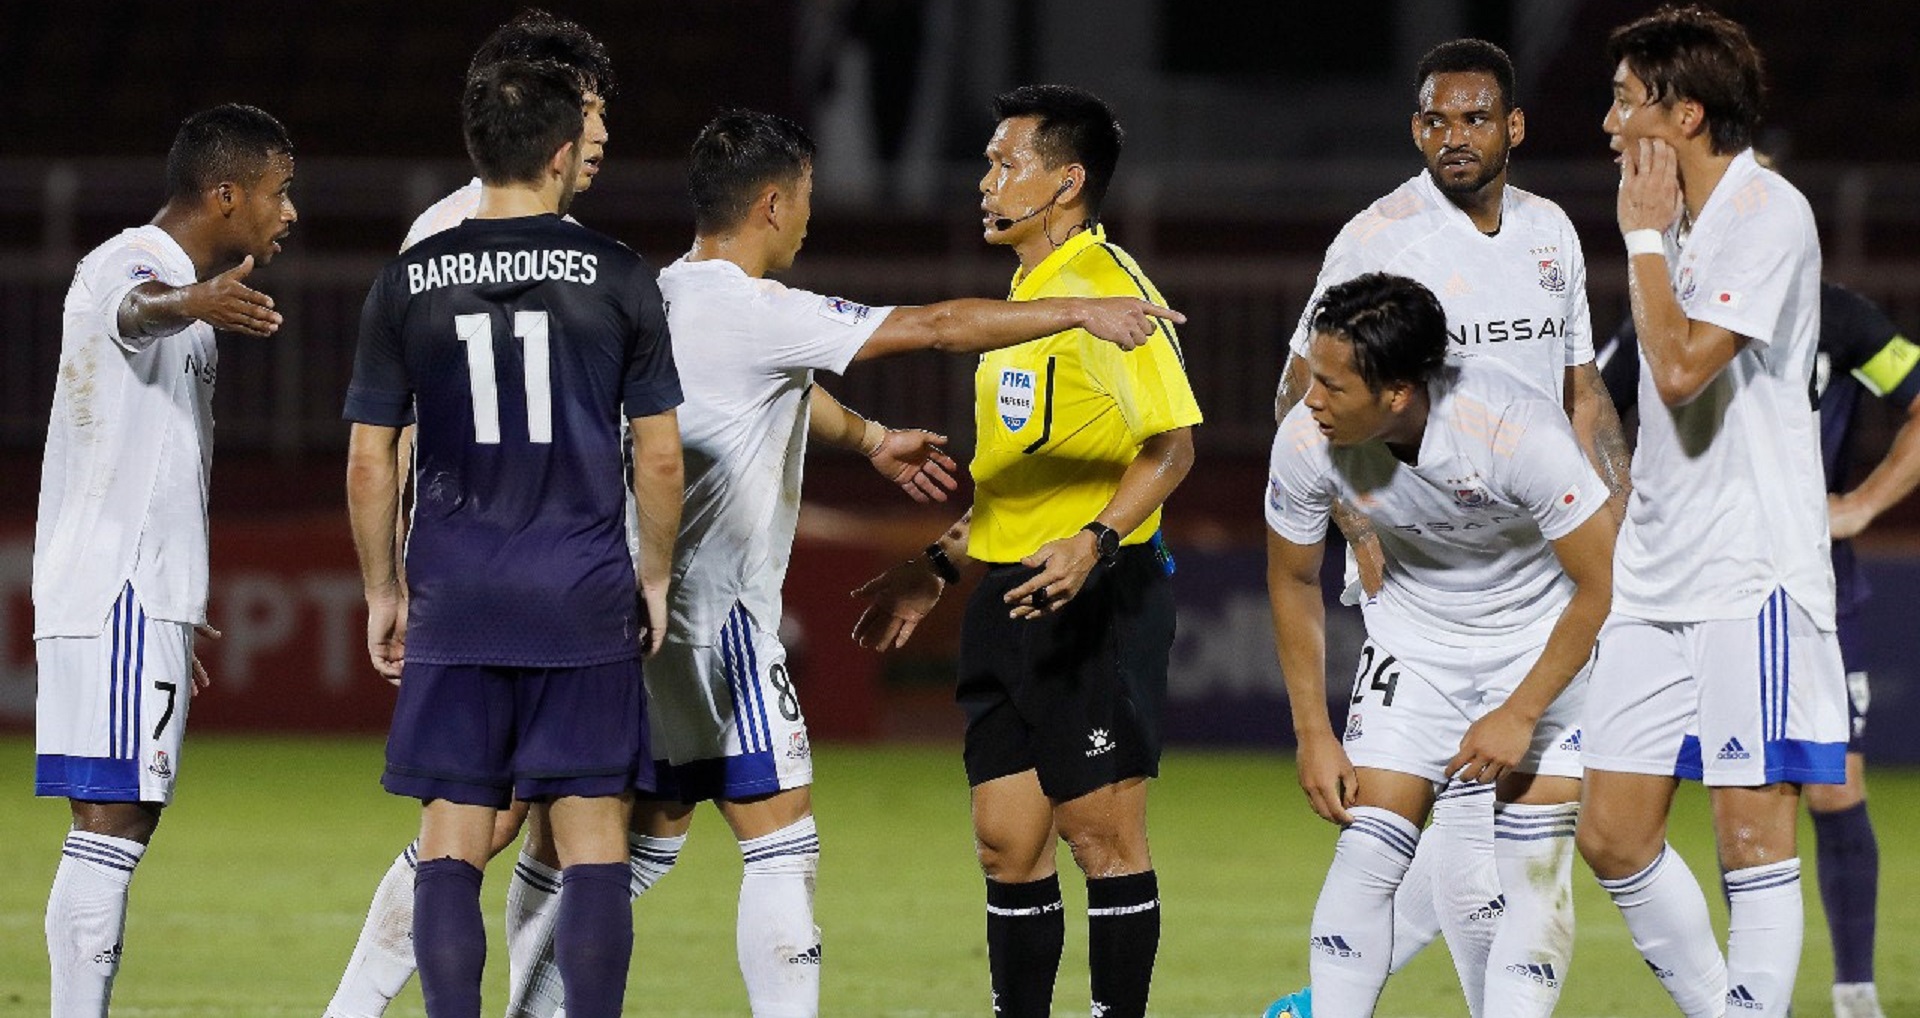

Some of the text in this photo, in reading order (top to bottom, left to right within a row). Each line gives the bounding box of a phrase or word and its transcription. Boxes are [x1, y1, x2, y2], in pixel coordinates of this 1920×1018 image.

[408, 250, 598, 294] BARBAROUSES
[454, 311, 552, 444] 11
[1001, 371, 1031, 389] FIFA
[769, 663, 799, 721] 8
[1352, 646, 1400, 706] 24
[153, 681, 176, 740] 7
[1716, 750, 1751, 760] adidas
